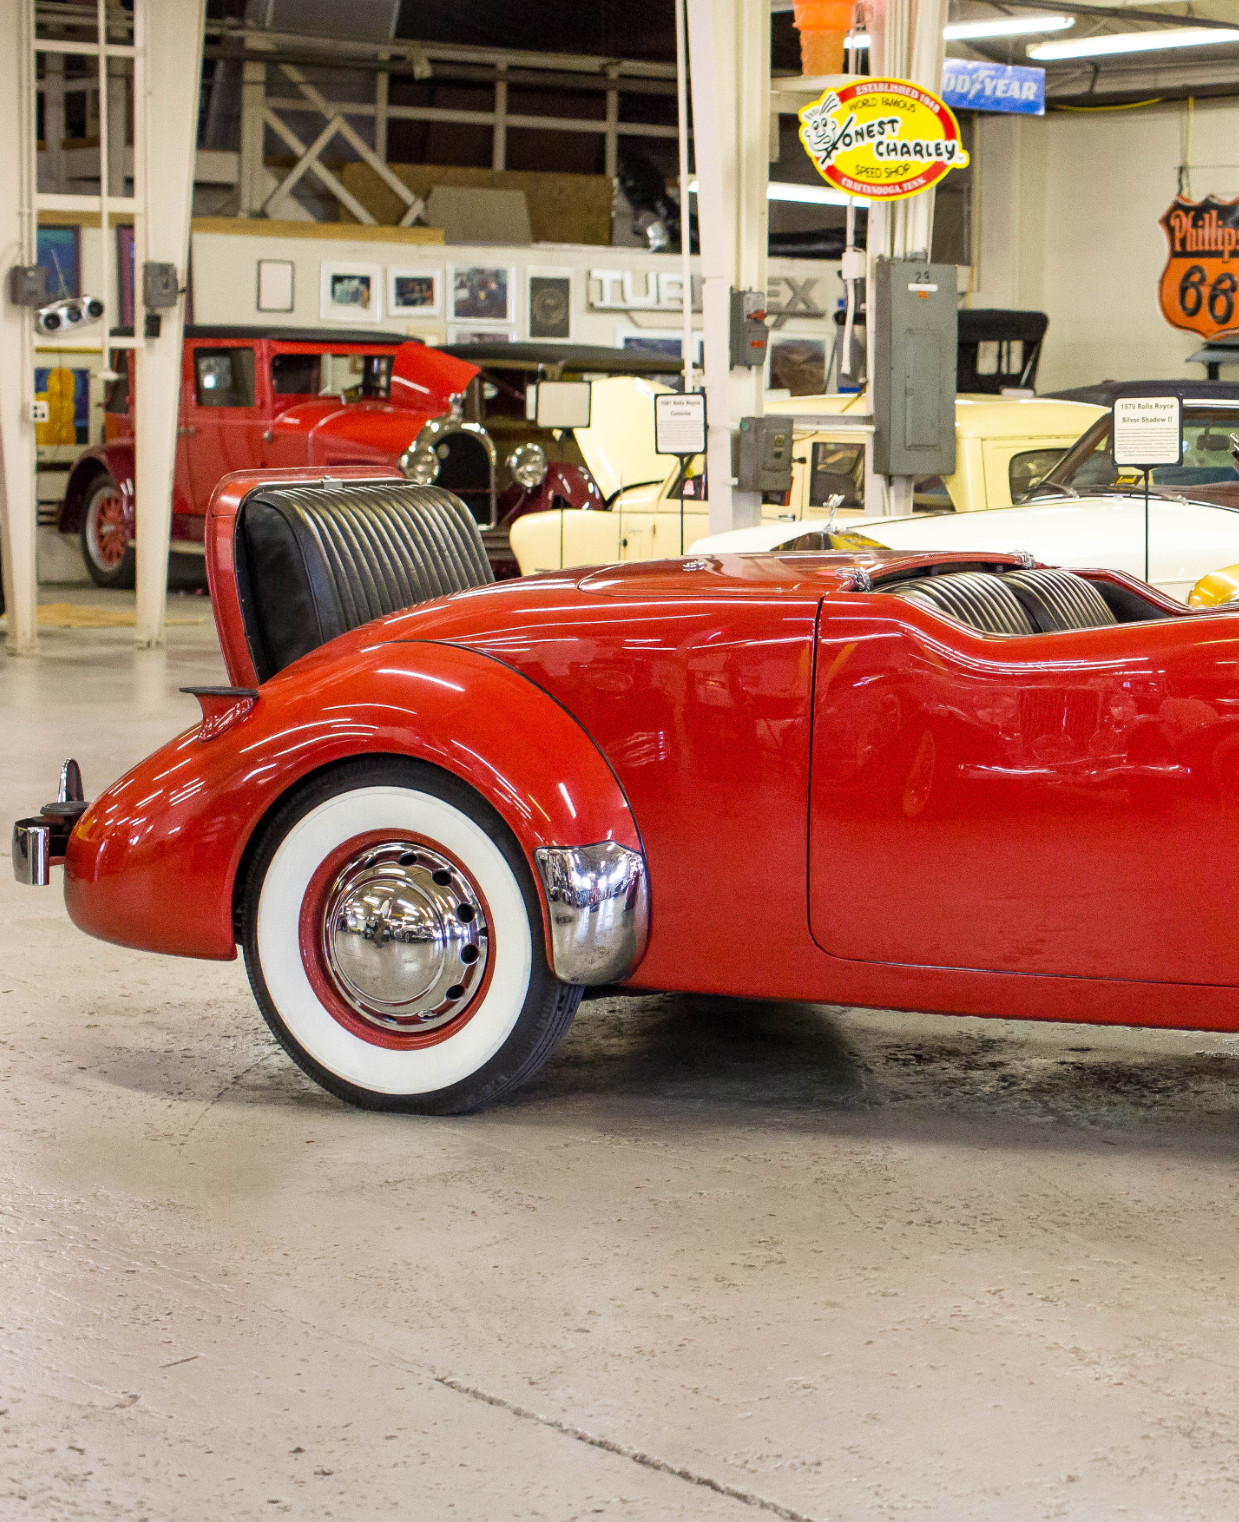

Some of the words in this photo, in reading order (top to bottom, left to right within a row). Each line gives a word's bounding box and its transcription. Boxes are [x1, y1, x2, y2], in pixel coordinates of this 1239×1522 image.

[856, 82, 919, 99] ESTABLISHED
[943, 72, 1037, 100] ODYEAR
[849, 97, 877, 111] WORLD
[881, 97, 916, 113] FAMOUS
[875, 140, 956, 160] CHARLEY
[855, 164, 882, 178] SPEED
[885, 163, 910, 178] SHOP
[1179, 264, 1239, 325] 66
[1154, 402, 1174, 411] Royce
